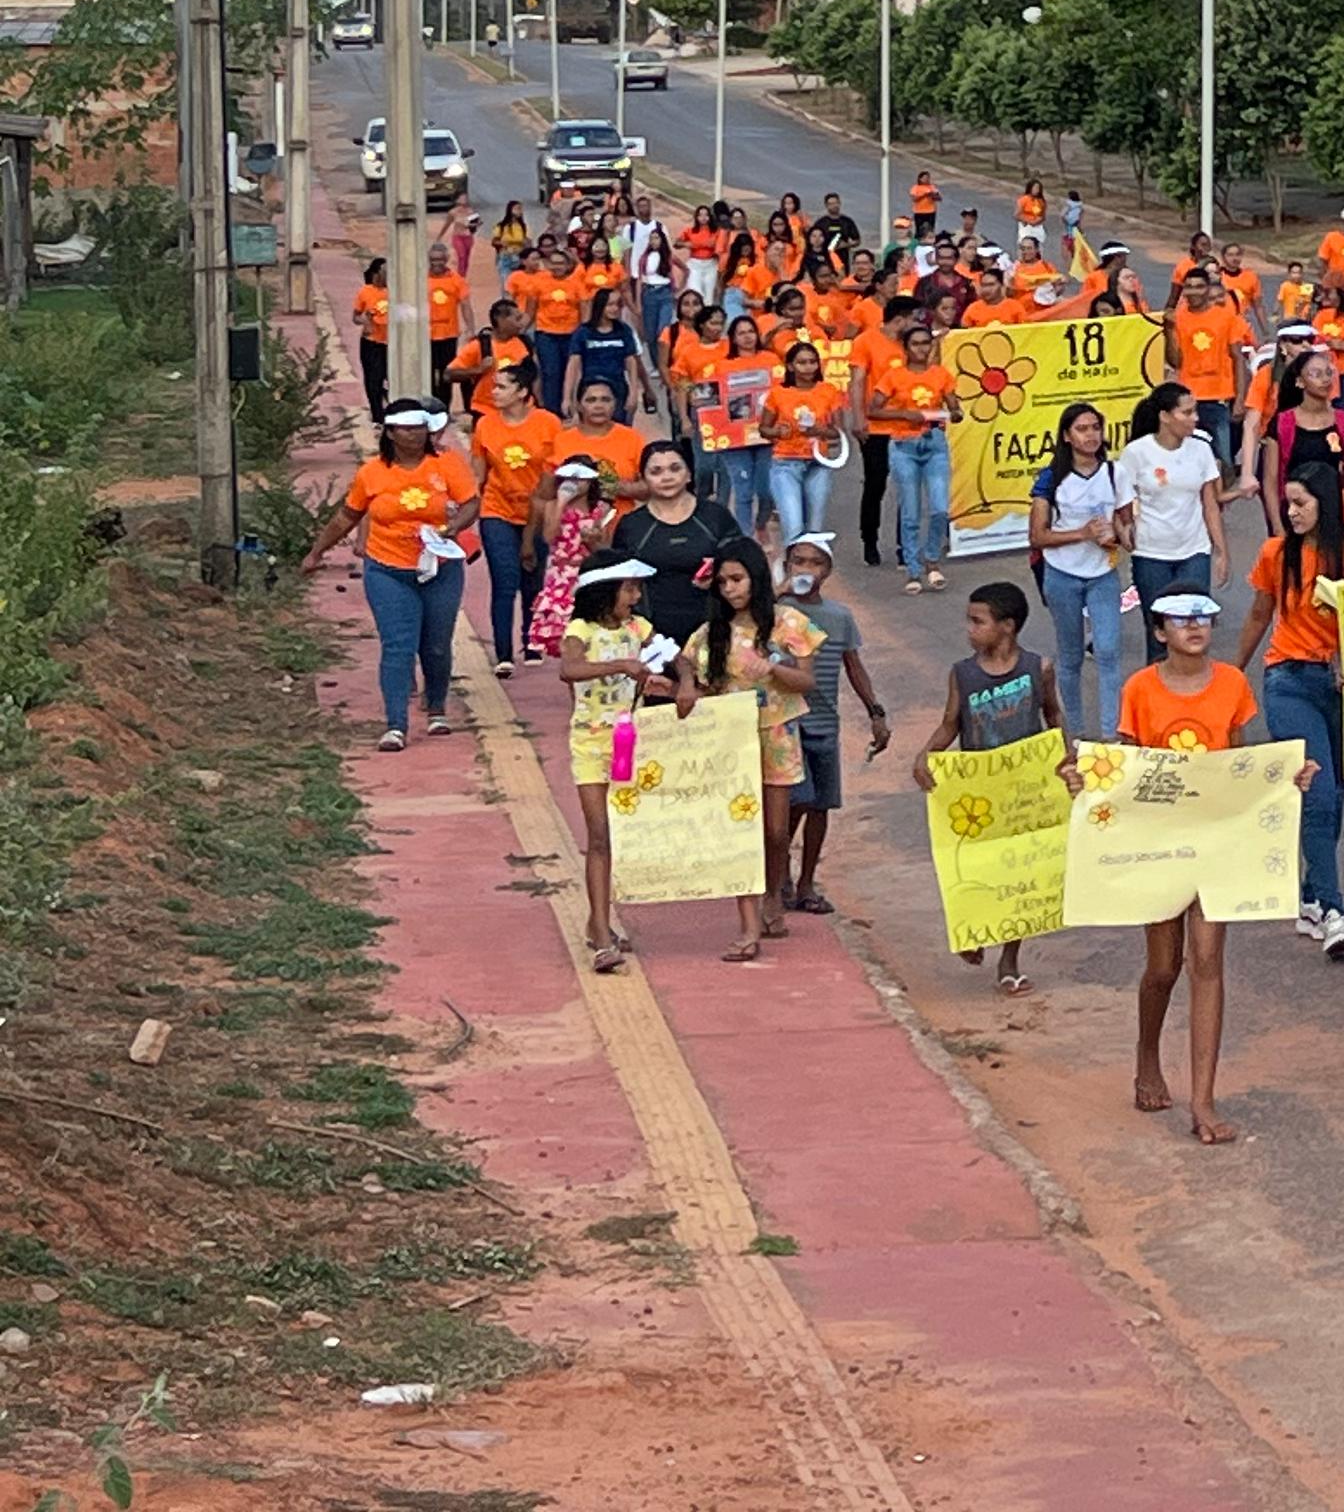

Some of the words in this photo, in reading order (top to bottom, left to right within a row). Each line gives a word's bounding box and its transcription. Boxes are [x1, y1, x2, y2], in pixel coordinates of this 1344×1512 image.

[1064, 322, 1106, 366] 18
[994, 431, 1056, 465] FAÇA
[969, 674, 1032, 707] GAMER
